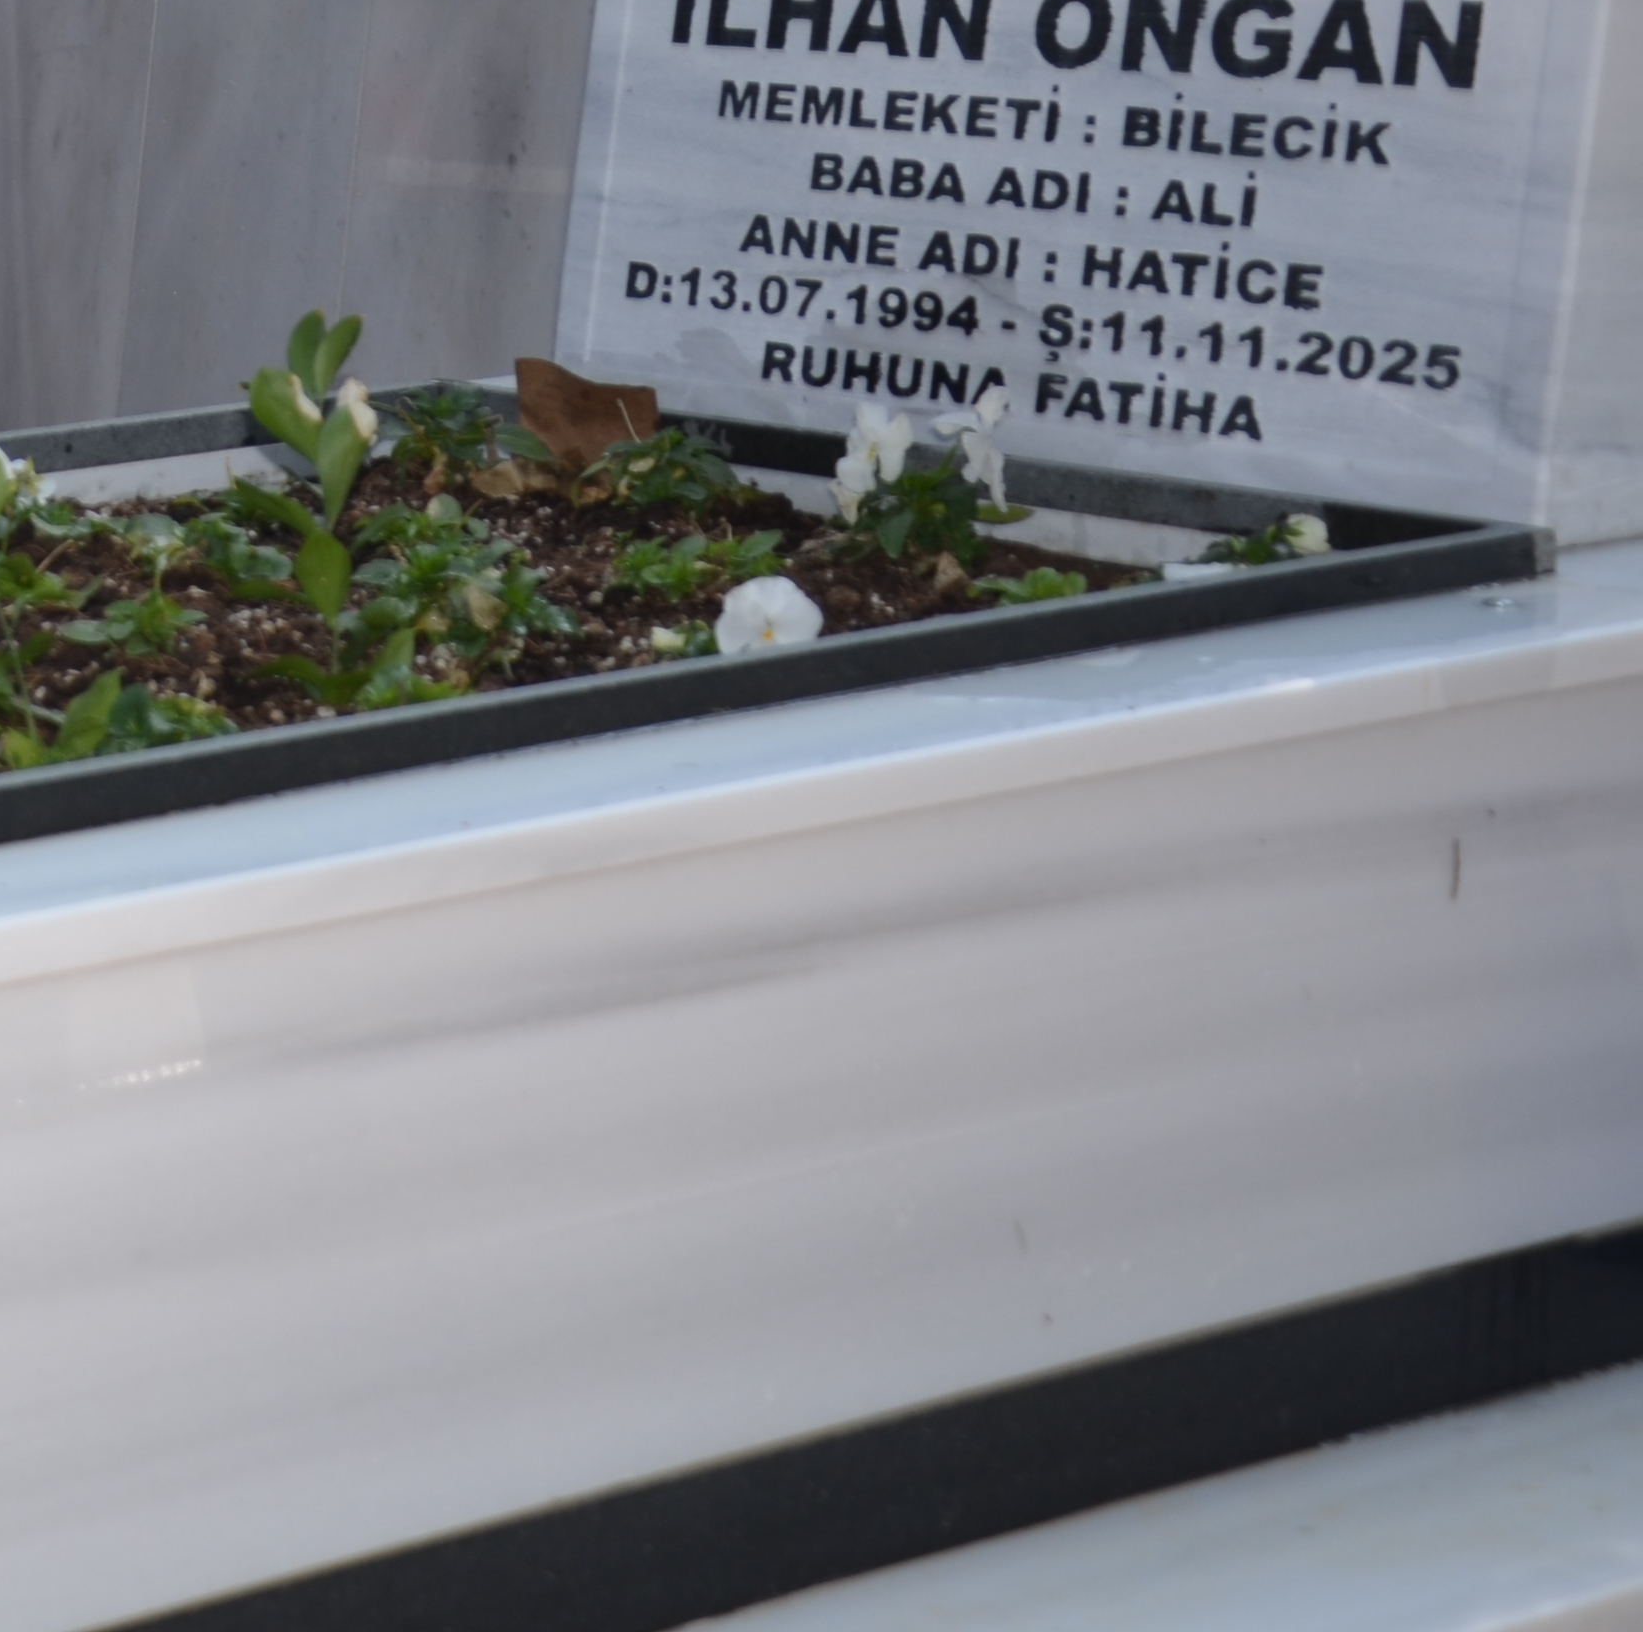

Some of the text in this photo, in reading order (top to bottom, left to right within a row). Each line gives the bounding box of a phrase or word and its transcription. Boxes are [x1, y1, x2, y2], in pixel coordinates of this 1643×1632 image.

[717, 80, 1061, 143] MEMLEKETİ
[1124, 92, 1393, 167] BİLECİK
[810, 154, 965, 202] BABA
[986, 168, 1091, 213] ADI
[1151, 172, 1259, 228] ALİ
[739, 215, 899, 268] ANNE
[917, 231, 1019, 278] ADI
[1083, 240, 1326, 310] HATİCE
[625, 261, 981, 337] D:13.07.1994
[1039, 304, 1463, 392] Ş:11.11.2025
[1035, 372, 1265, 443] FATİHA
